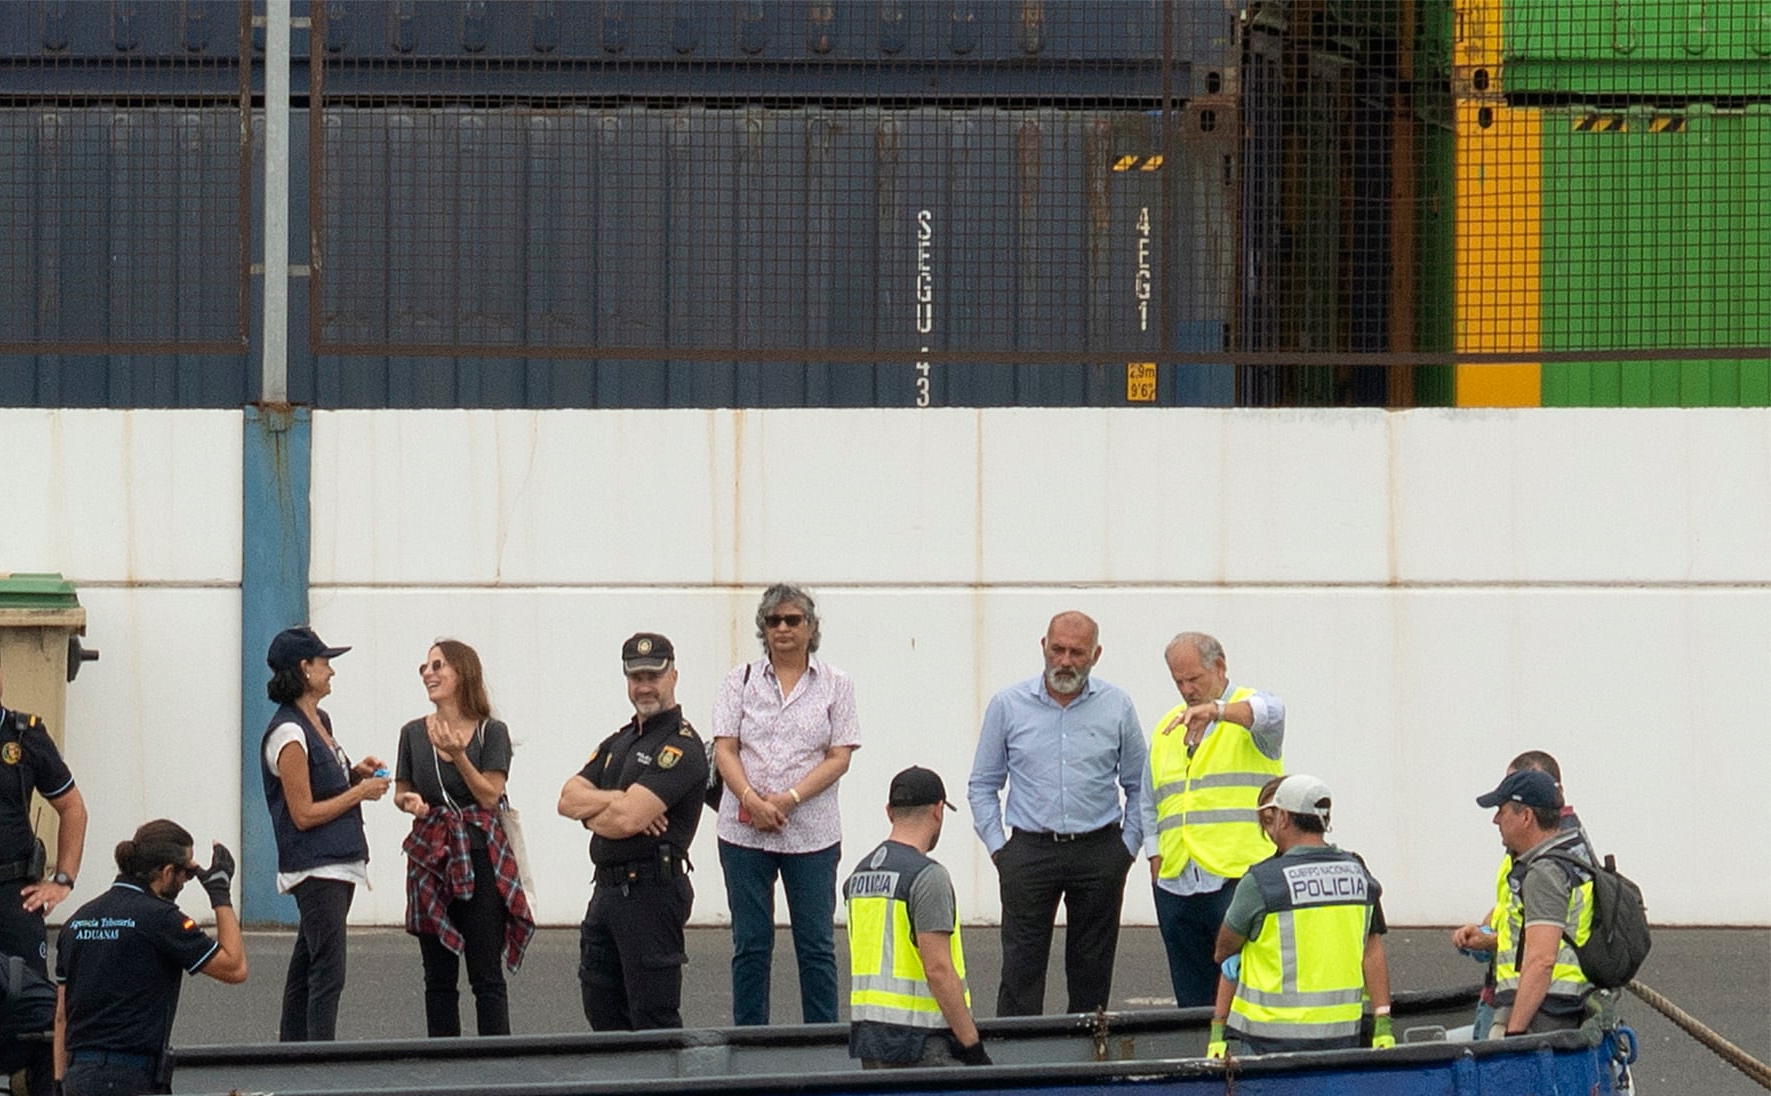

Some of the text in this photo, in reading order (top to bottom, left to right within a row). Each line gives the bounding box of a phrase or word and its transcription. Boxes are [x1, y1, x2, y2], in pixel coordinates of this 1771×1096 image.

[916, 210, 932, 333] SEGU
[1135, 207, 1151, 331] 4EG1
[1292, 877, 1365, 900] POLICIA
